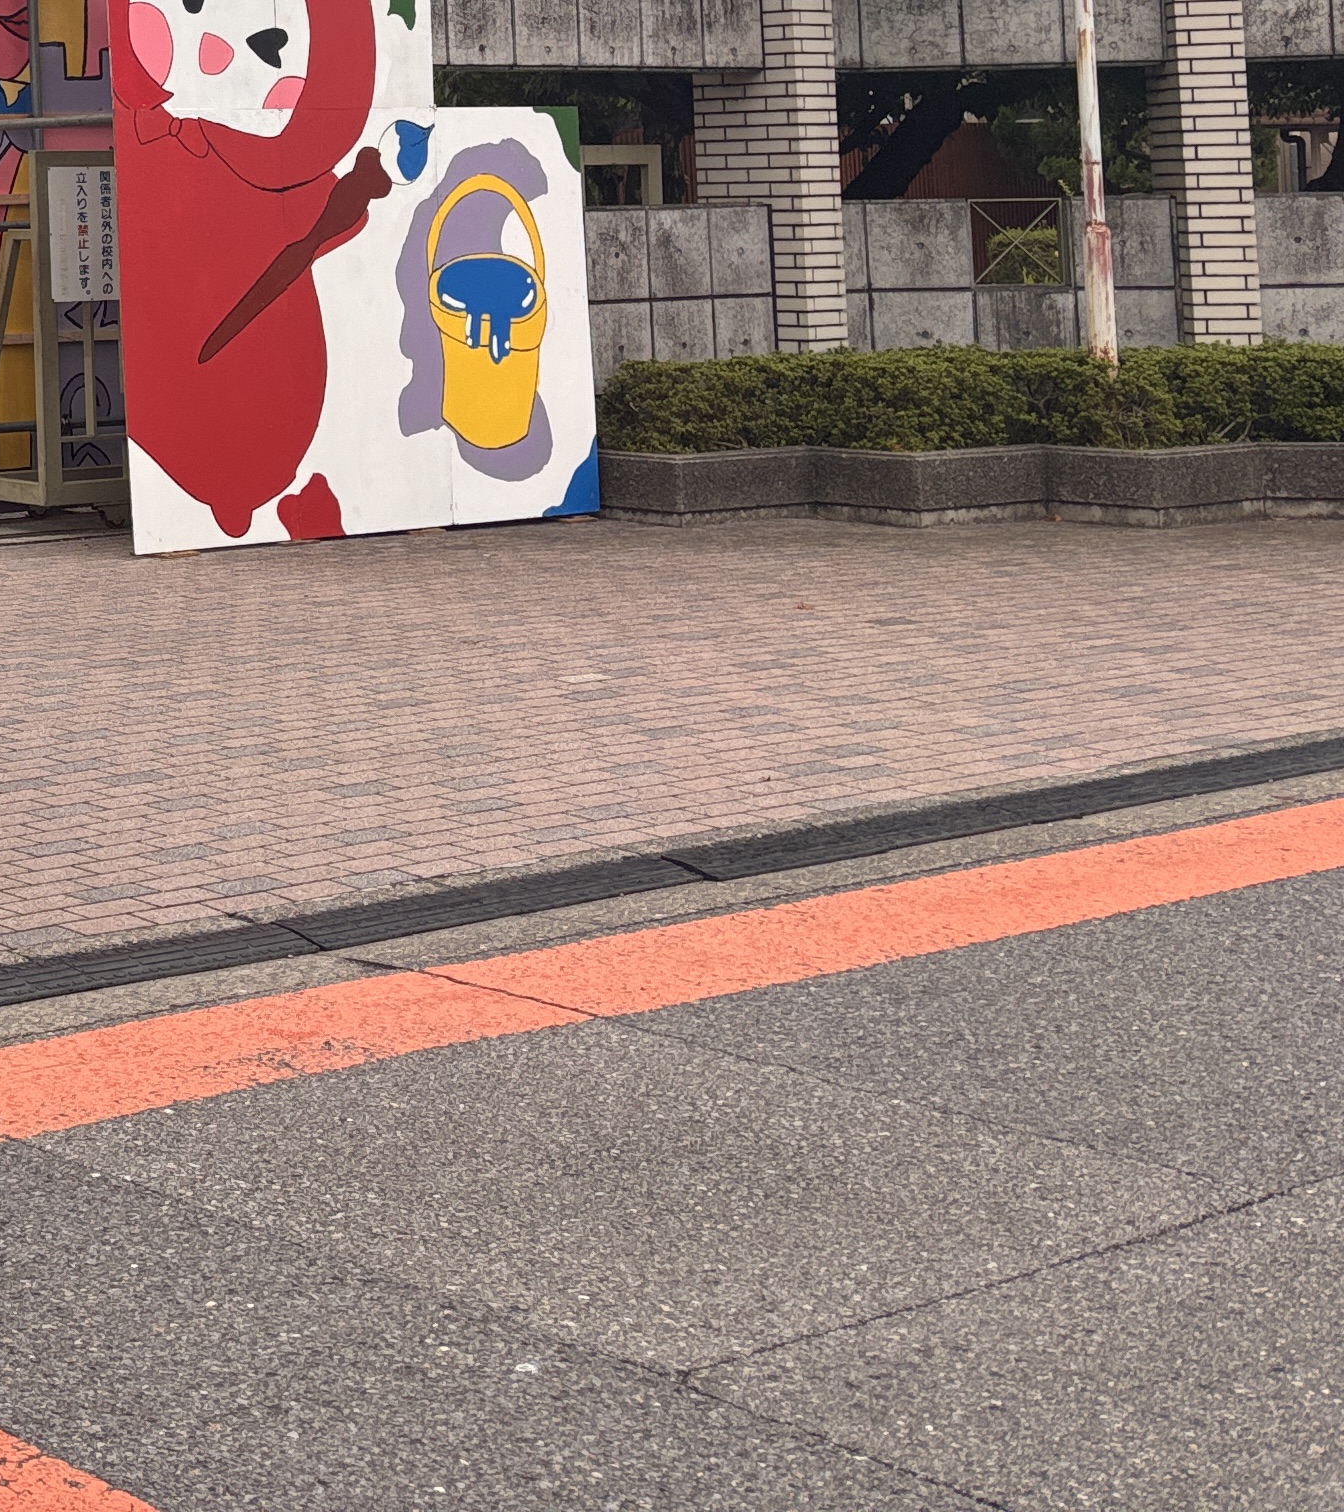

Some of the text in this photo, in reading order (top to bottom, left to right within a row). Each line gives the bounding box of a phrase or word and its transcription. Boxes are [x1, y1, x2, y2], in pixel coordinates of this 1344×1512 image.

[75, 172, 91, 296] 立入りを禁止します。
[99, 170, 114, 295] 関係者以外の校内への
